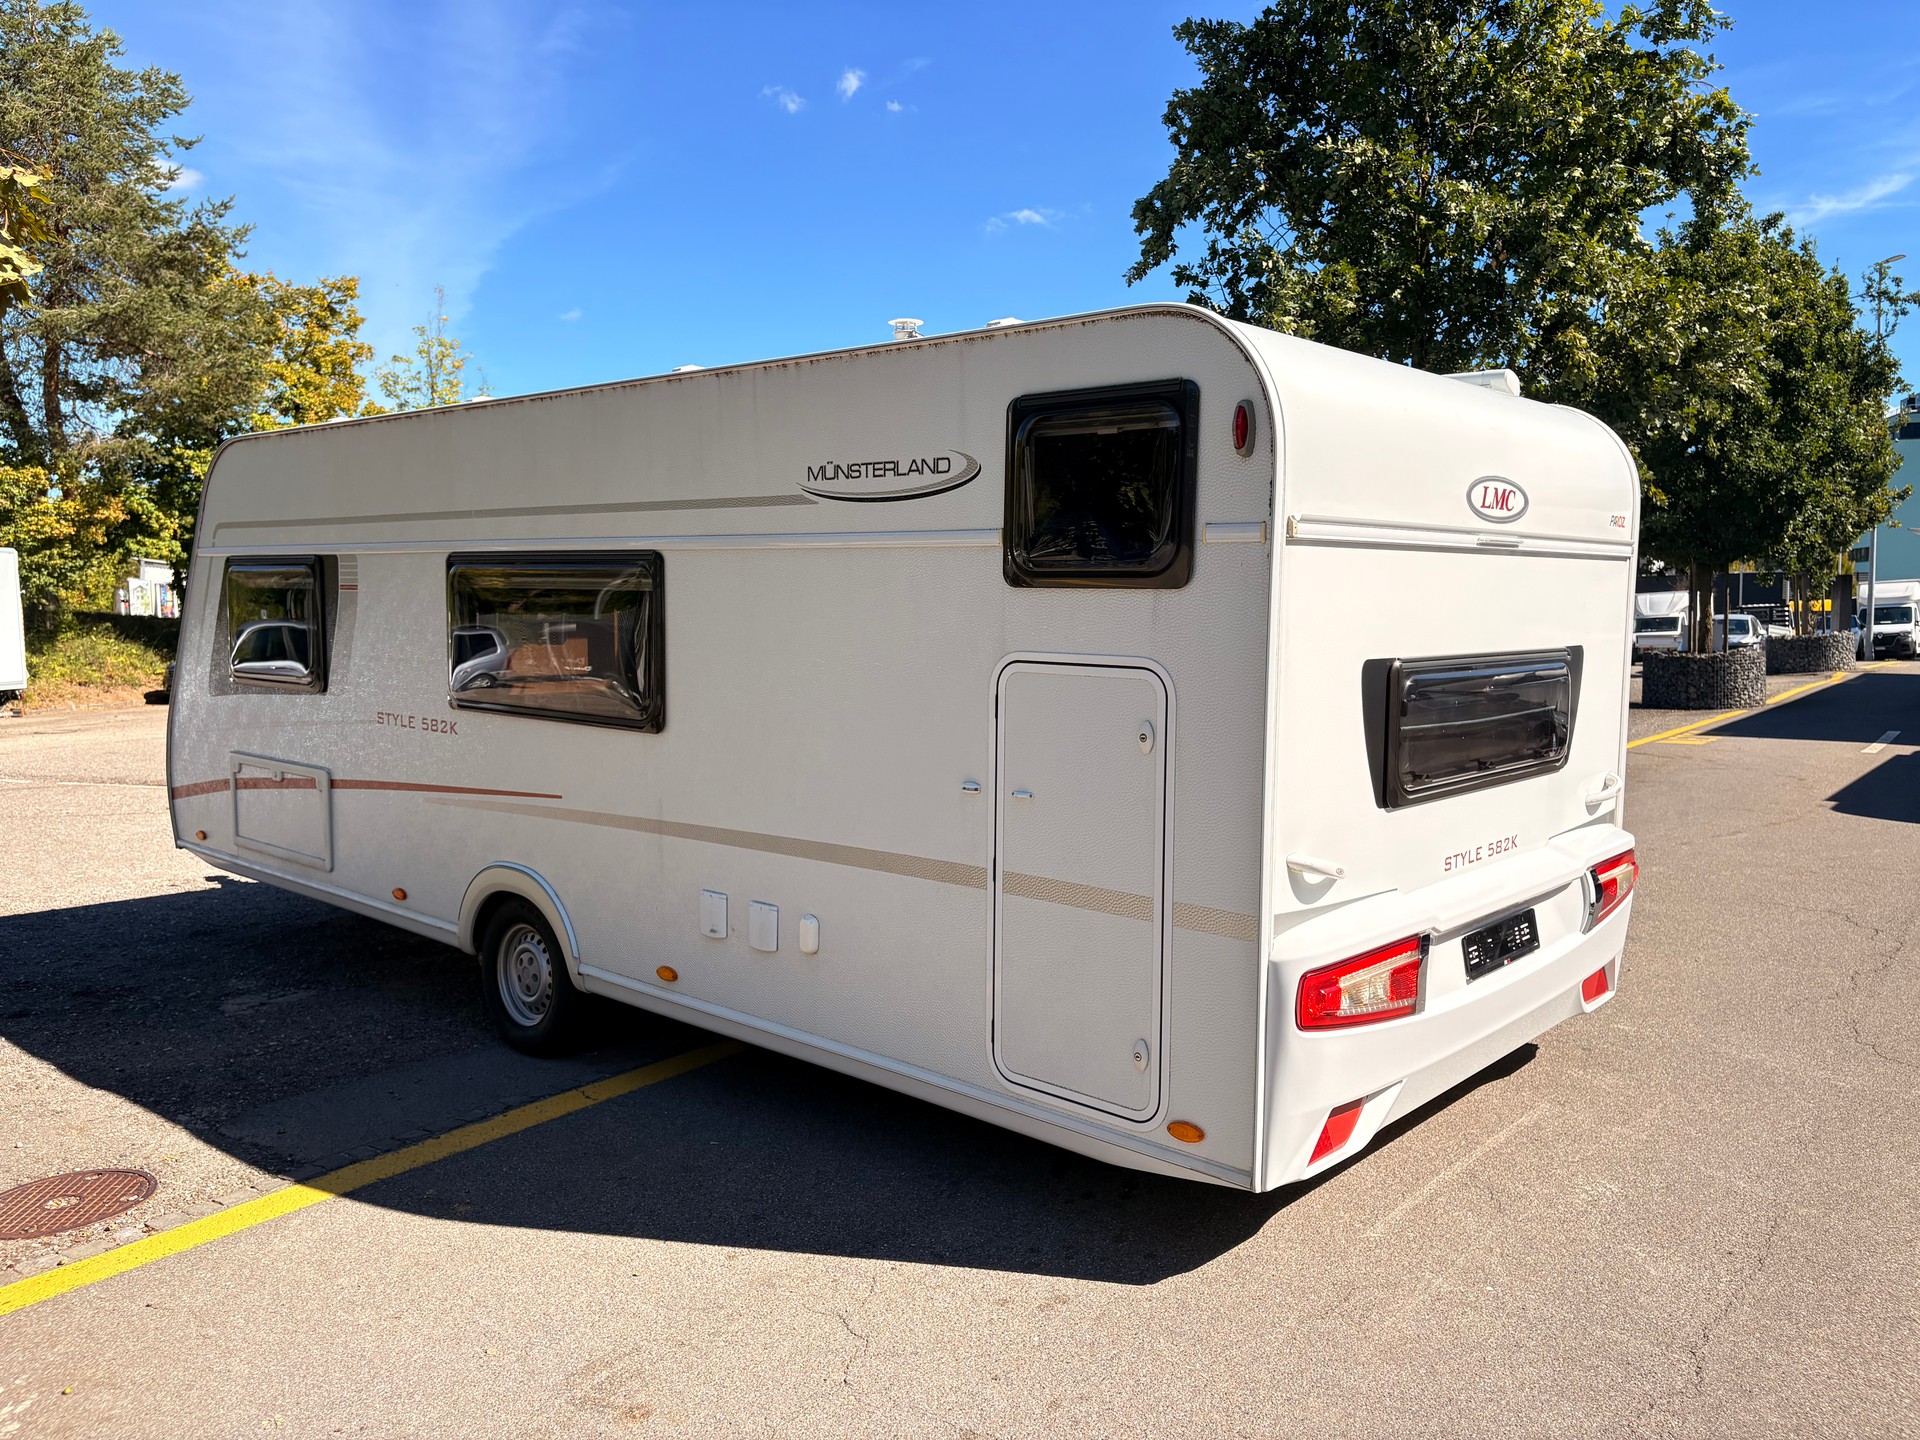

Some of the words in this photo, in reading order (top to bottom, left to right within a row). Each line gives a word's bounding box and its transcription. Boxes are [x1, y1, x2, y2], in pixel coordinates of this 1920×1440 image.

[807, 457, 951, 482] MÜNSTERLAND
[1480, 485, 1516, 512] LMC
[377, 711, 416, 729] STYLE
[421, 717, 458, 735] 582K
[1444, 846, 1483, 872] STYLE
[1487, 834, 1518, 857] 582K
